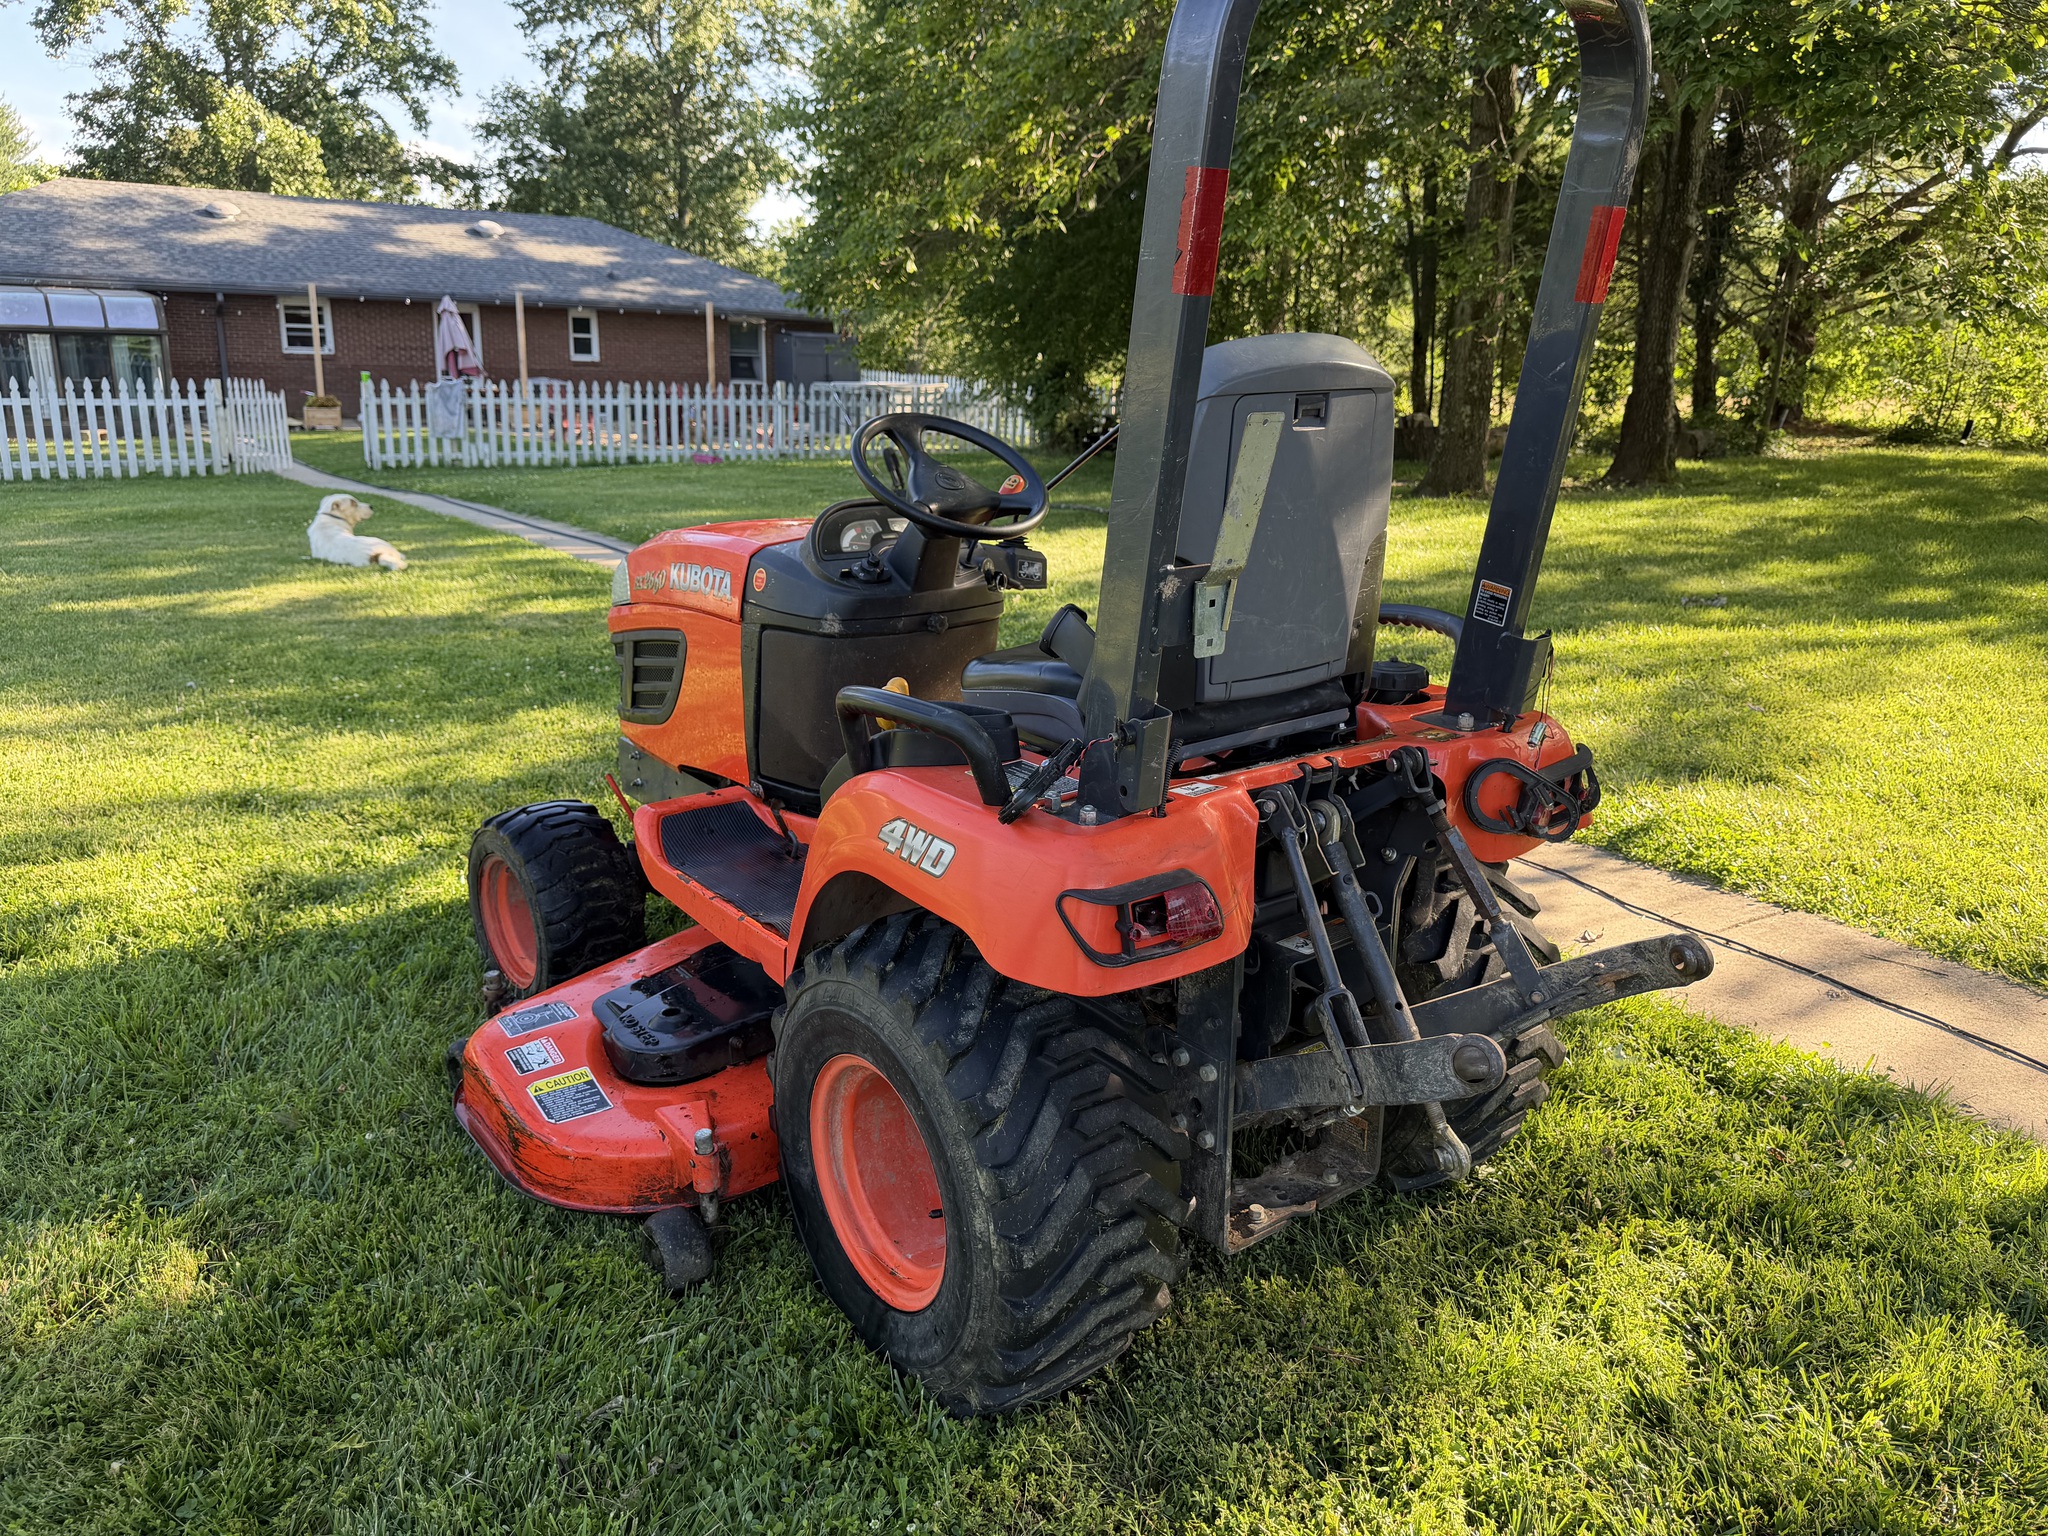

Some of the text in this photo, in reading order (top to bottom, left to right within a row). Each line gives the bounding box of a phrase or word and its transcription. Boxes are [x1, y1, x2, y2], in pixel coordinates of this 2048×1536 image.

[669, 562, 731, 601] KUBOTA
[877, 815, 957, 879] 4WD
[543, 1041, 563, 1065] DANGER
[545, 1070, 590, 1090] CAUTION
